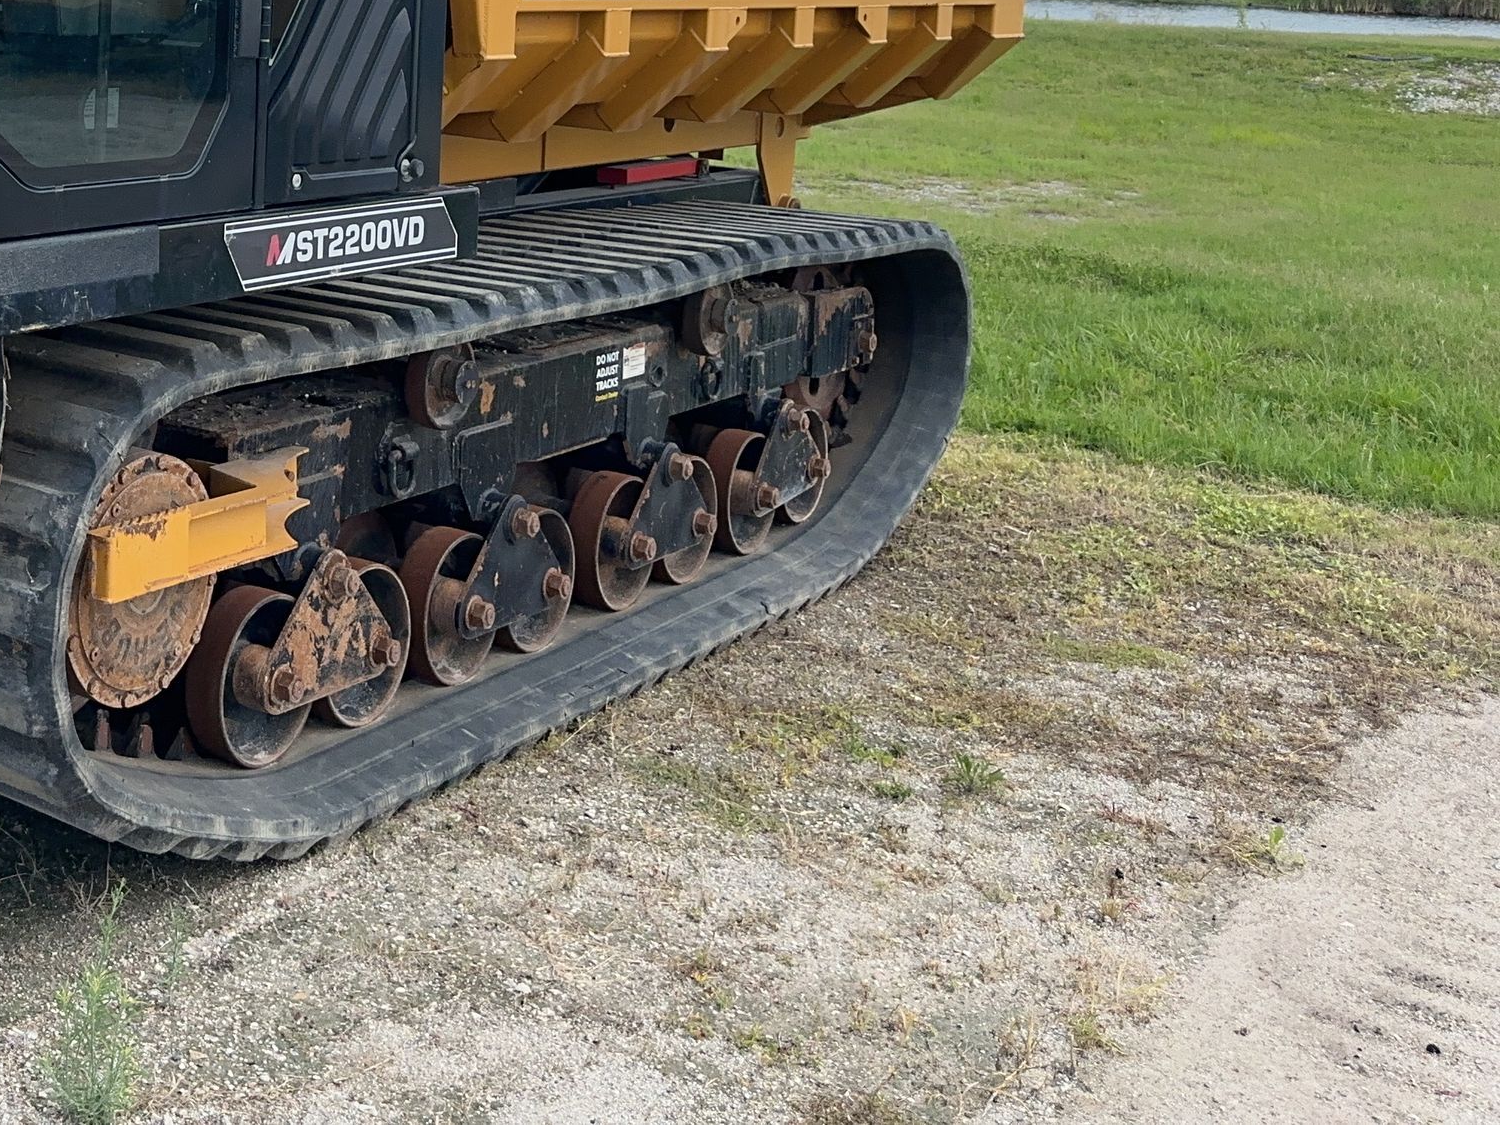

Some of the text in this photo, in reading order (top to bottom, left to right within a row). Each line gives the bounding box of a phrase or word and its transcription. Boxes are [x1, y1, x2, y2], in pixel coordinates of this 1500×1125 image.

[266, 215, 425, 267] MST2200VD
[596, 354, 606, 365] DO
[607, 351, 619, 362] NOT
[596, 364, 619, 378] ADJUST
[596, 377, 619, 391] TRACKS
